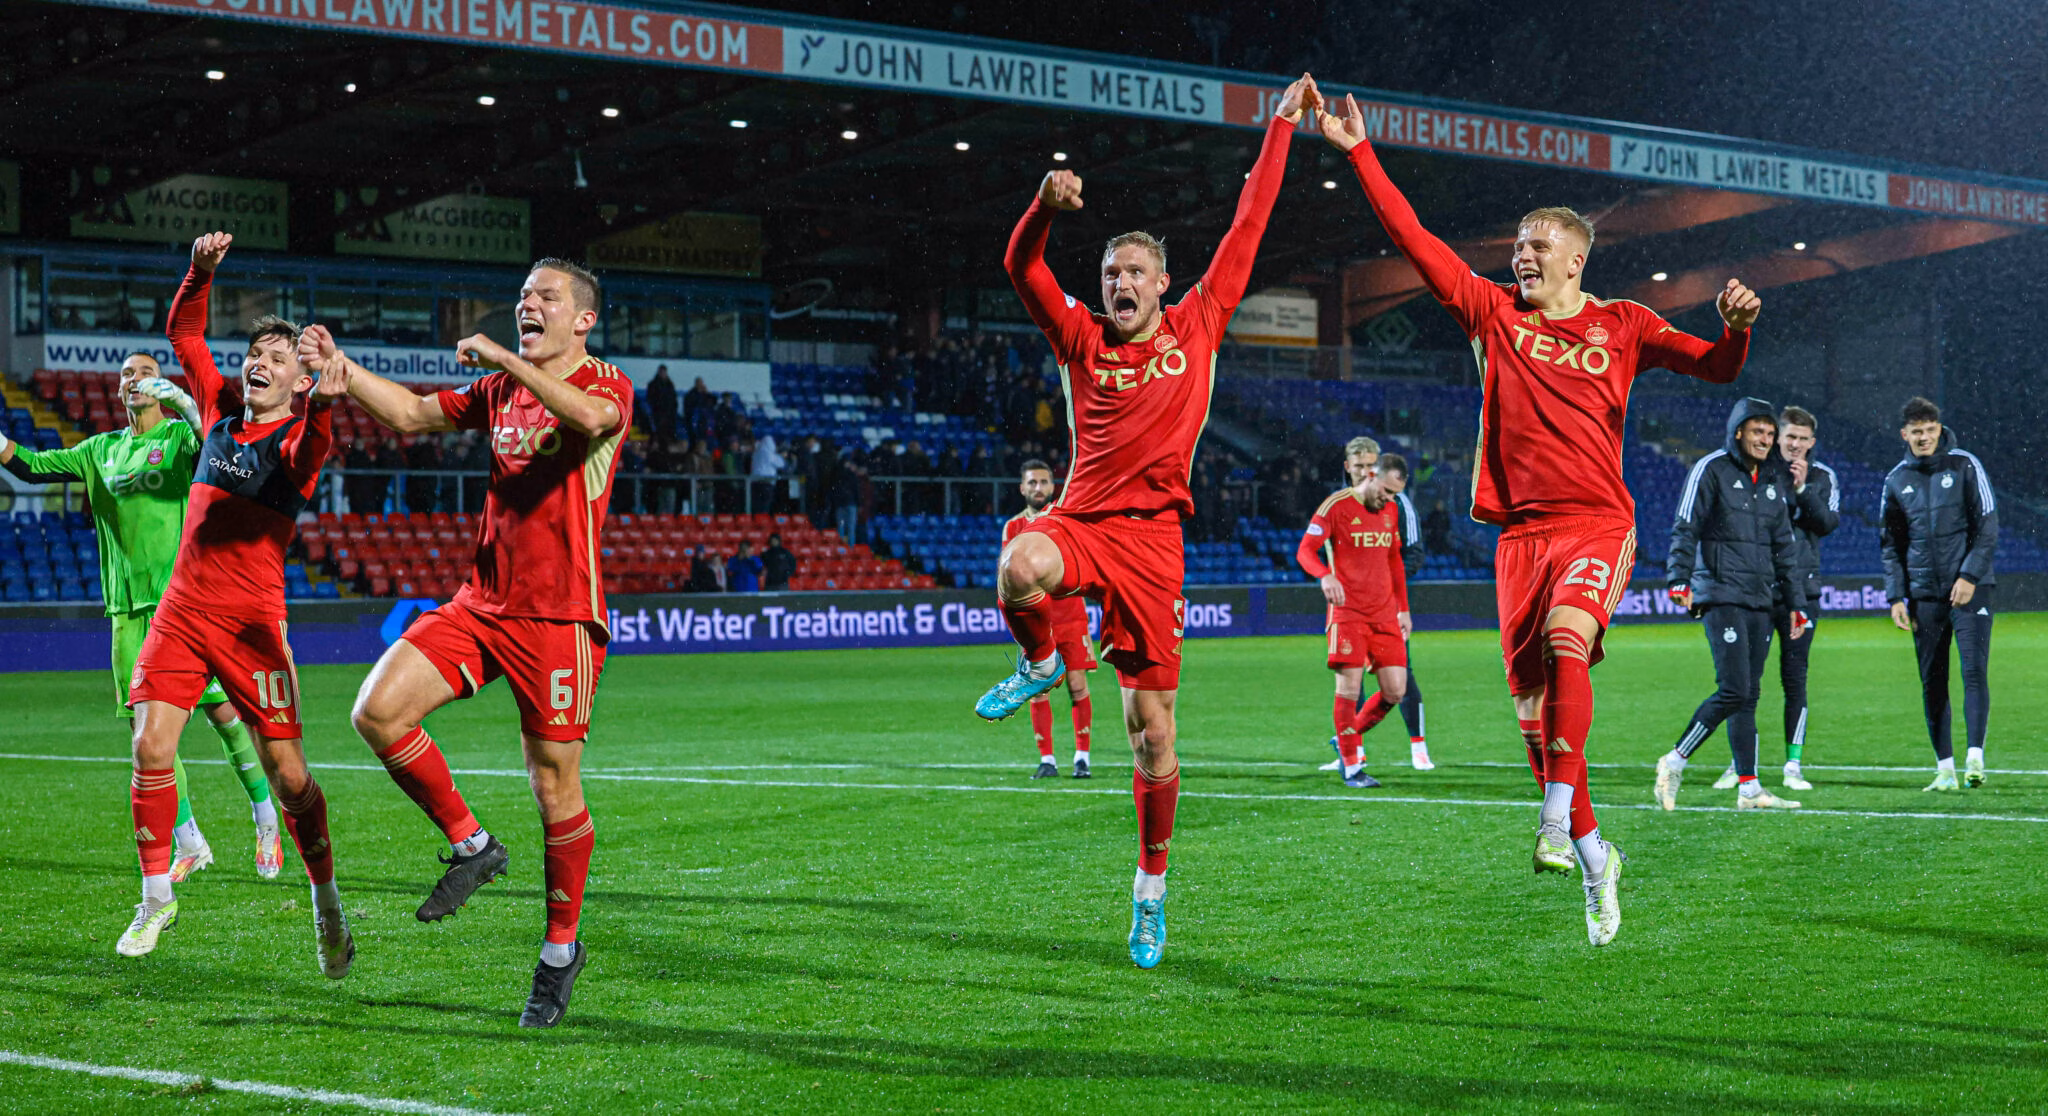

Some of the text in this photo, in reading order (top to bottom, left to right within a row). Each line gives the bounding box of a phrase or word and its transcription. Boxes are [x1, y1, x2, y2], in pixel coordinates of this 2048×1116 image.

[836, 40, 1205, 115] JOHN LAWRIE METALS
[1641, 147, 1877, 200] JOHN LAWRIE METALS
[146, 189, 279, 214] MACGREGOR
[401, 206, 522, 229] MACGREGOR
[1513, 324, 1610, 374] TEXO
[1094, 348, 1187, 391] TEXO
[208, 457, 253, 479] CATAPULT
[1350, 532, 1392, 547] TEXO
[1564, 557, 1611, 590] 23
[656, 607, 756, 641] Water
[762, 604, 909, 639] Treatment
[914, 603, 935, 634] &
[1184, 600, 1232, 628] ions
[252, 670, 291, 709] 10
[550, 668, 573, 710] 6
